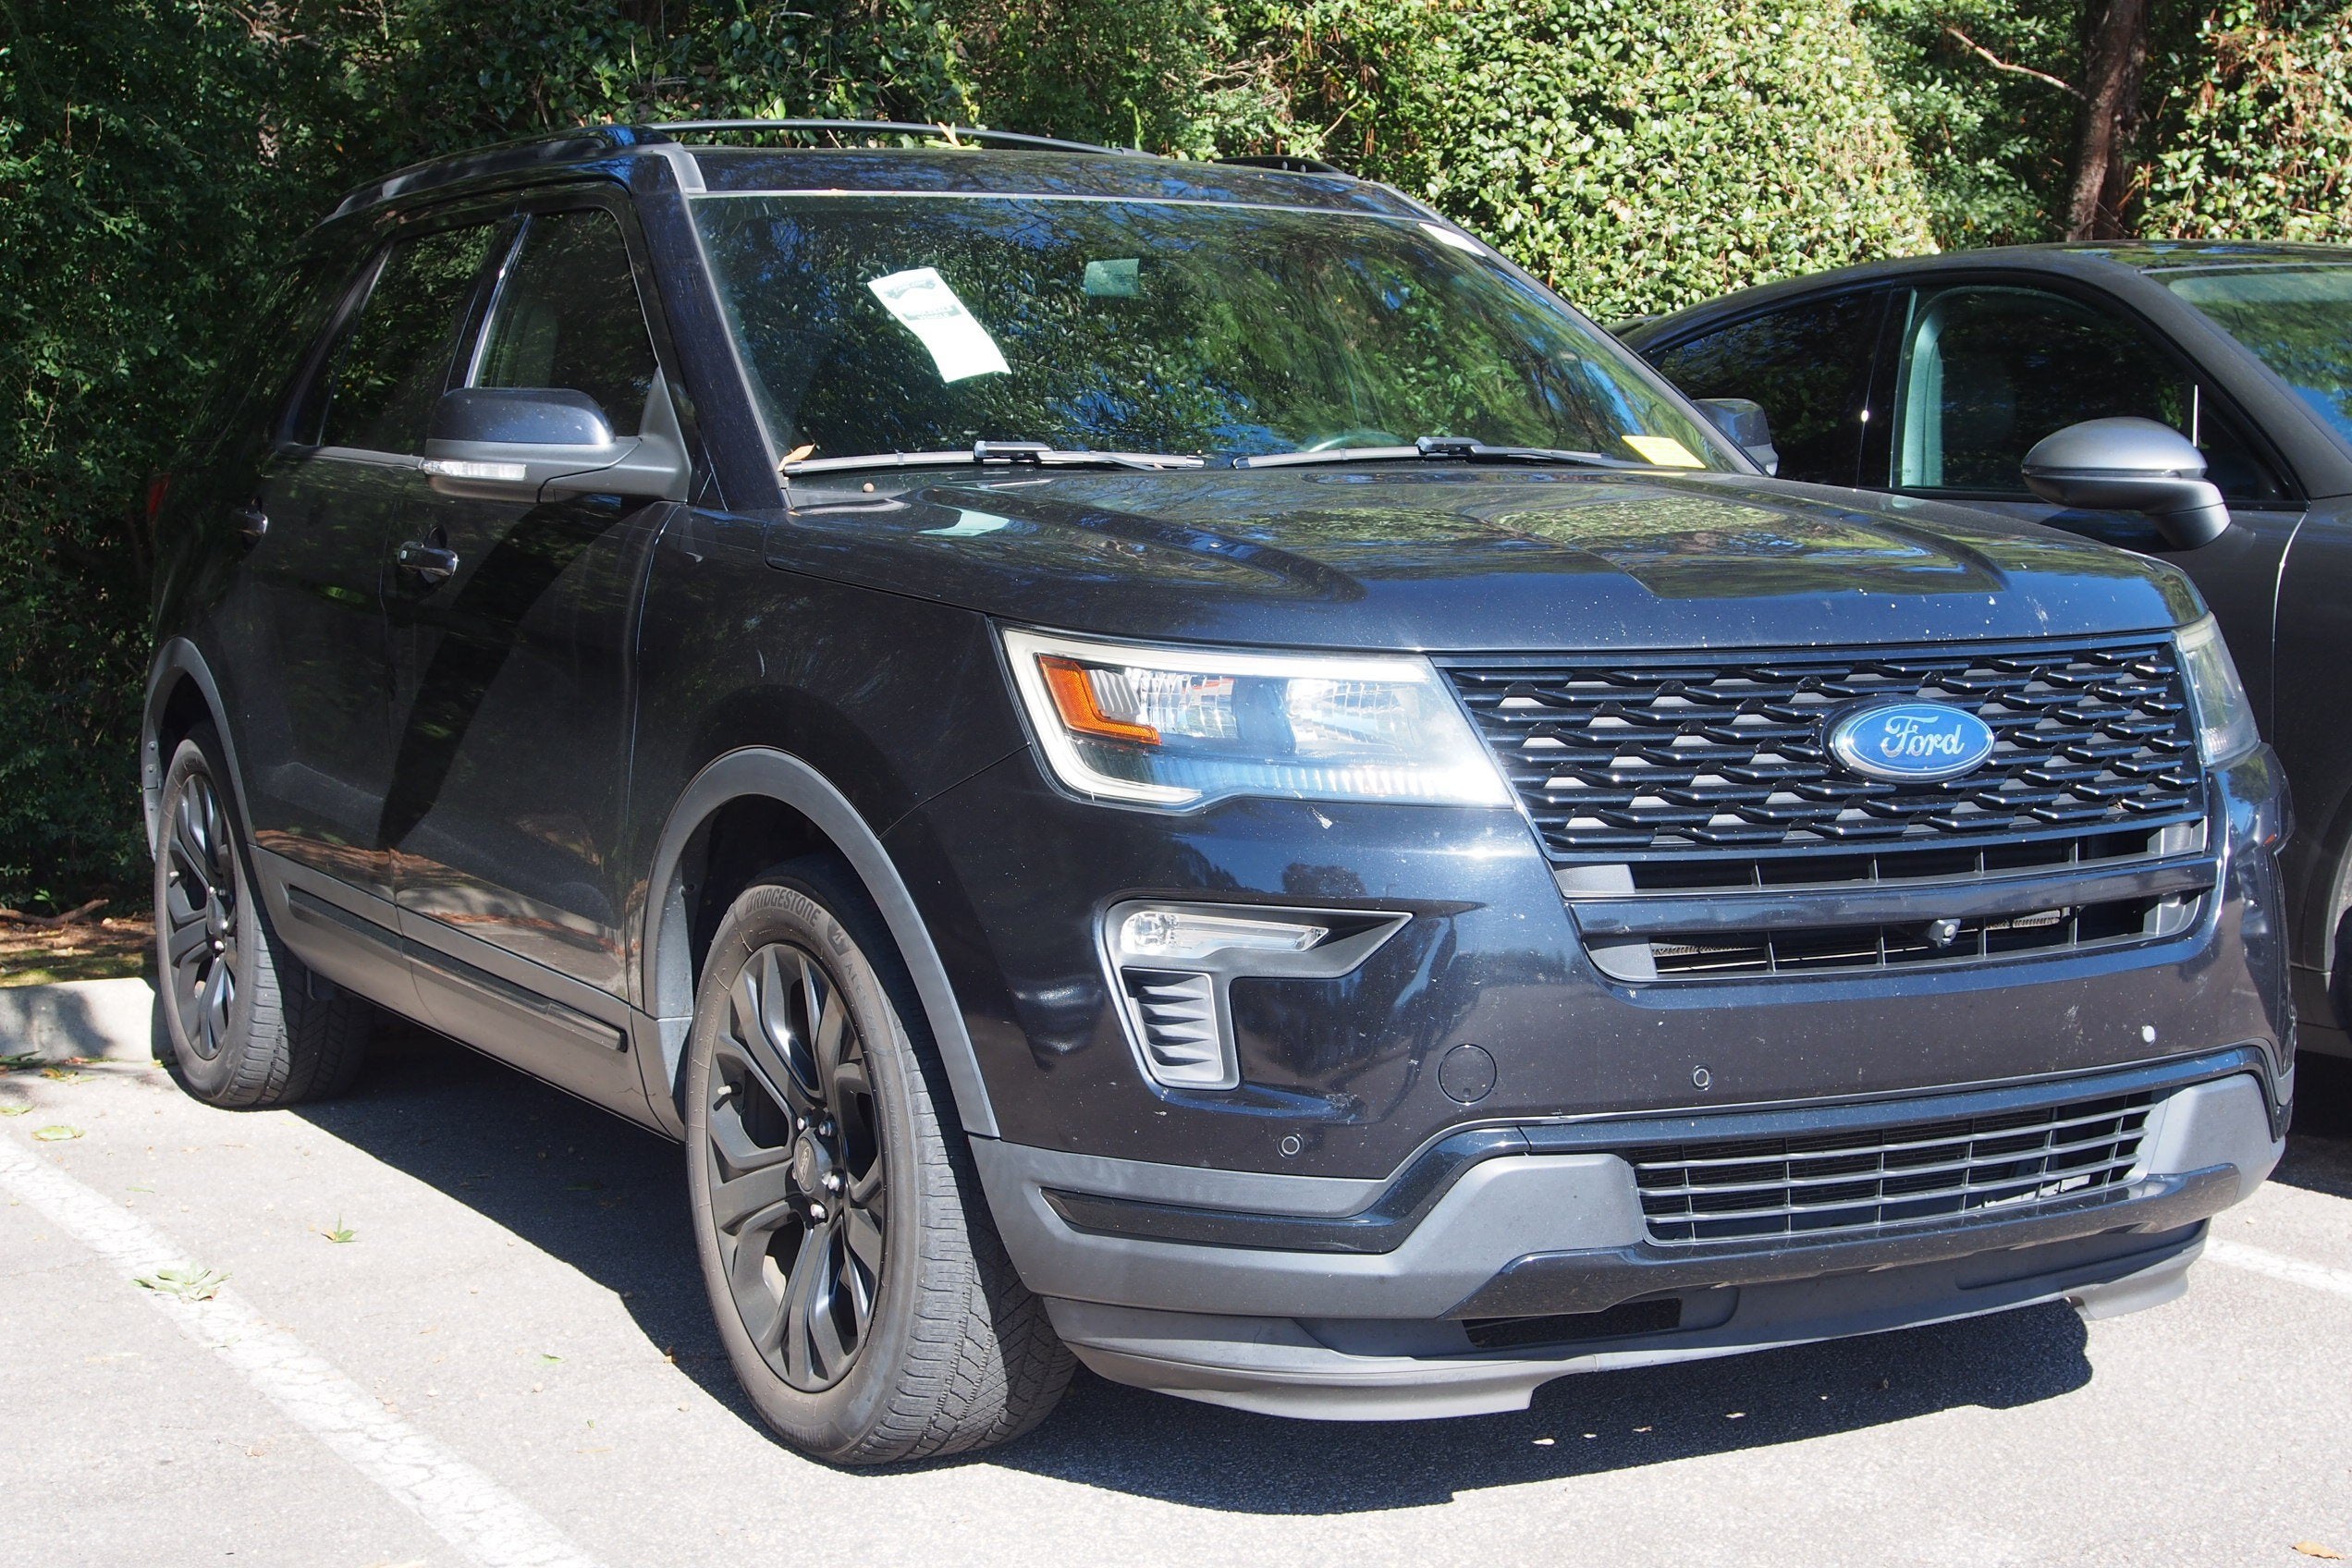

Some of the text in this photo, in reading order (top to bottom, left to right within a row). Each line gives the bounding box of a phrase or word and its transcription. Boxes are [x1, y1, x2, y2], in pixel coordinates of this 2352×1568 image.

[1881, 715, 1965, 757] Ford
[745, 888, 821, 927] BRIDGESTONE
[845, 962, 876, 1036] ALENZA
